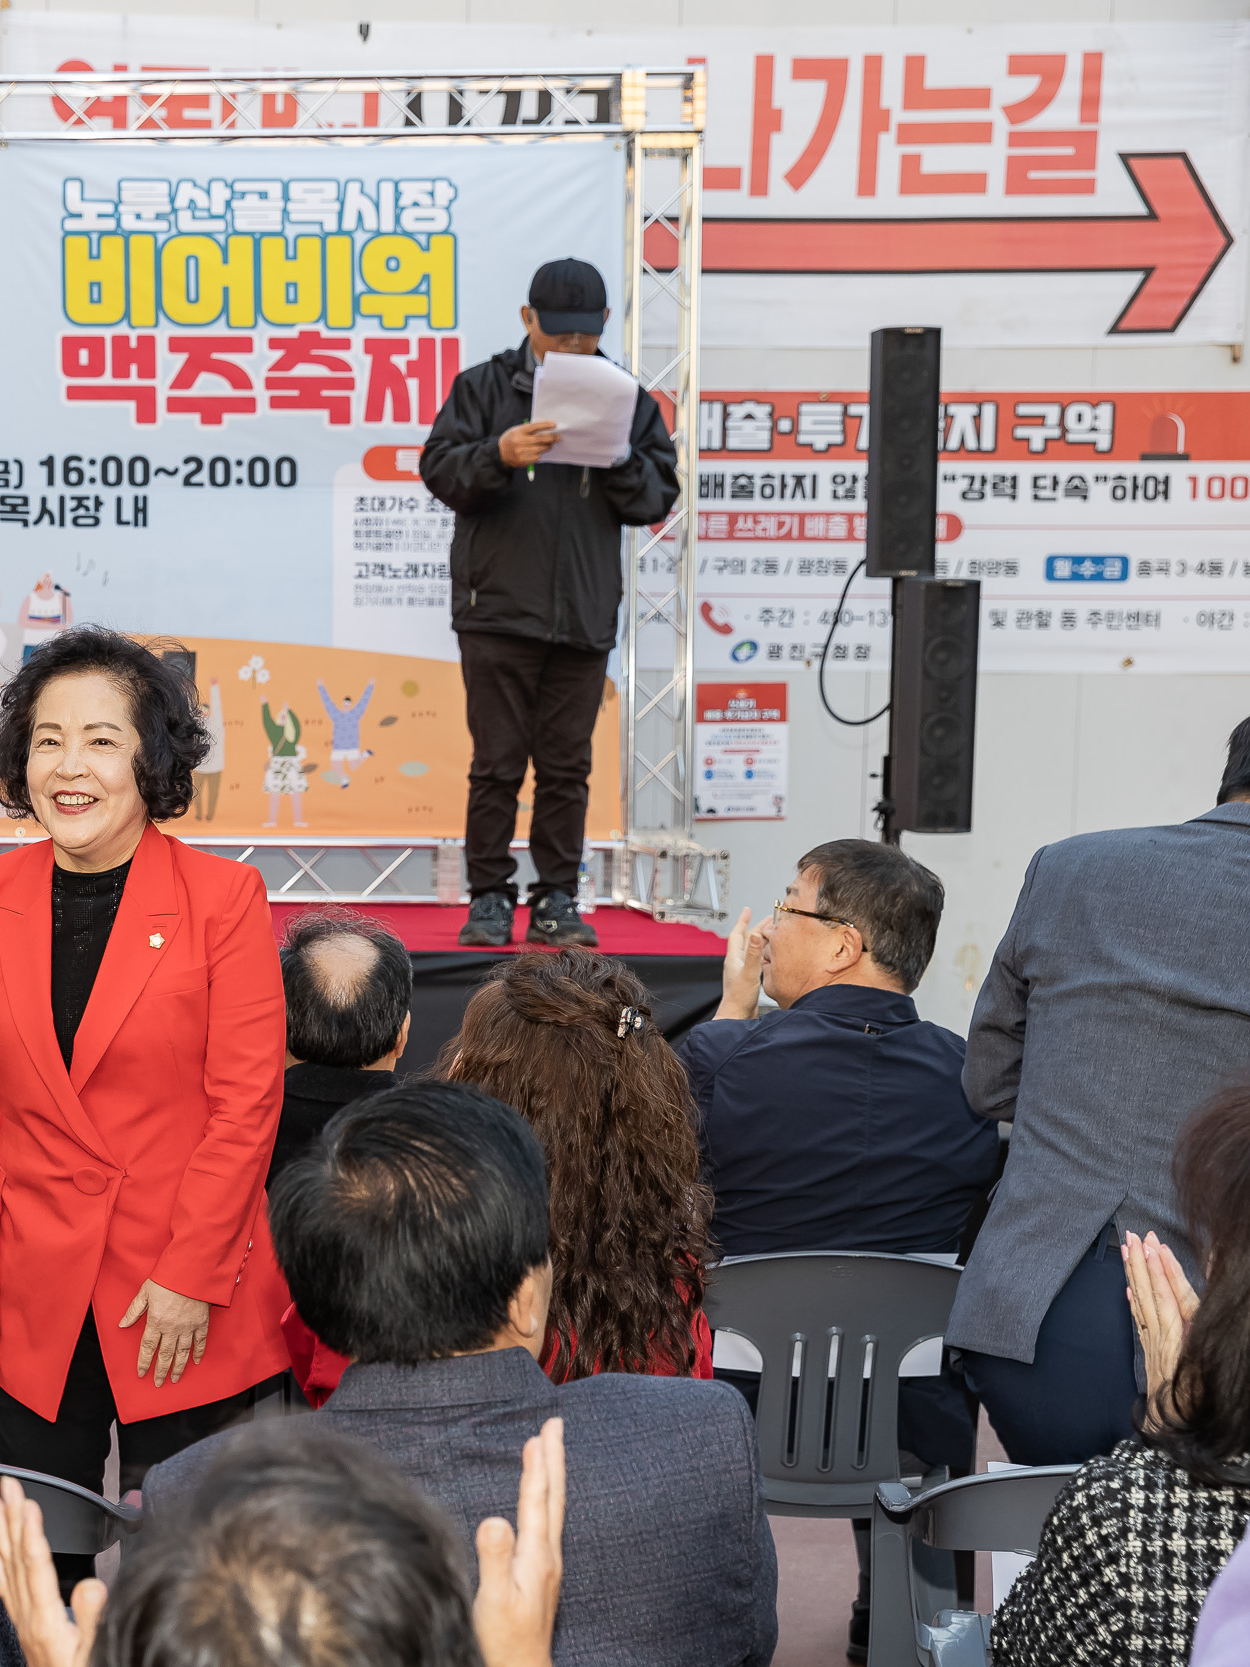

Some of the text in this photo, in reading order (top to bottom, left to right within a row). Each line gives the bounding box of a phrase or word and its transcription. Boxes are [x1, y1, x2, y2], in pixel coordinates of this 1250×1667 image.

[61, 177, 457, 233] 노룬산골목시장
[63, 233, 458, 329] 비어비워
[61, 331, 462, 425] 맥주축제
[1012, 402, 1116, 453] 구역
[39, 455, 298, 487] 16:00~20:00
[116, 495, 149, 528] 내
